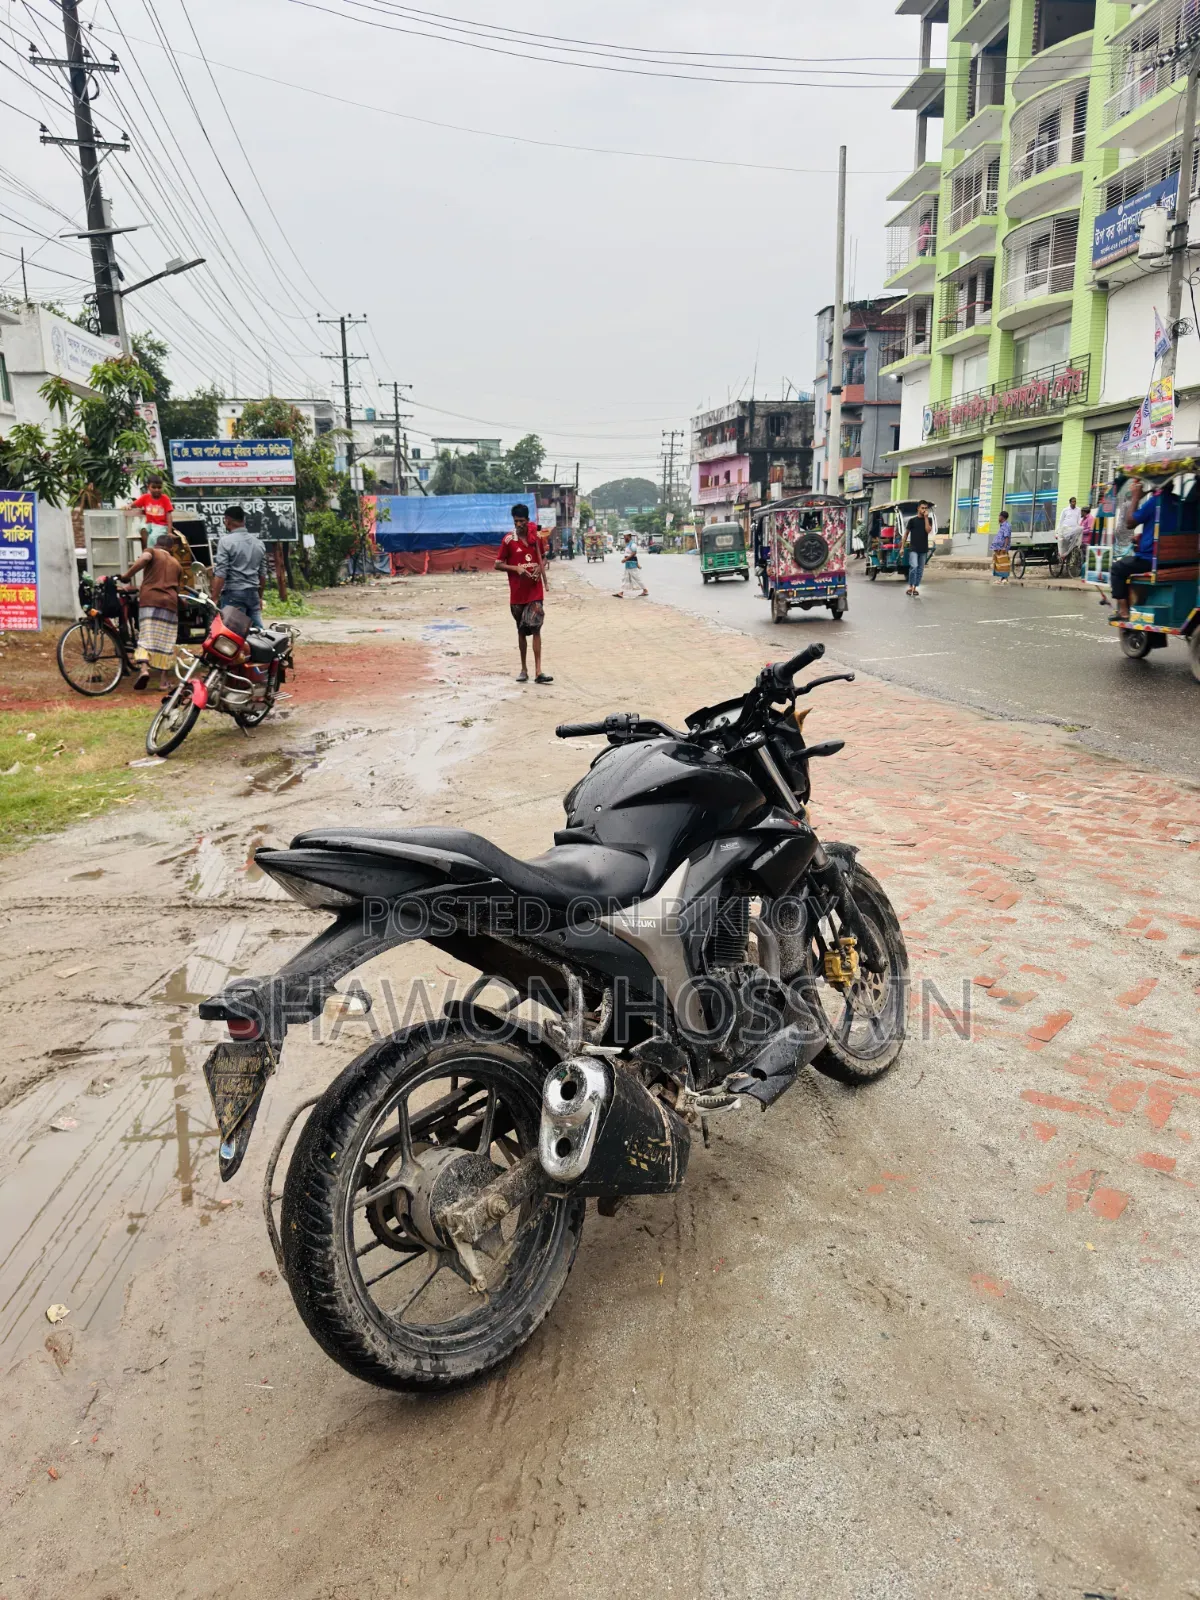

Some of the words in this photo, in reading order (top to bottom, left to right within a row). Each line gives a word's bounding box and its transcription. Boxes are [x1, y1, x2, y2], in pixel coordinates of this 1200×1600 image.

[204, 444, 221, 457] পার্সেল
[243, 498, 267, 515] হাই
[267, 500, 295, 516] স্কুল
[3, 525, 34, 542] সার্ভিস
[622, 919, 656, 928] SUZUKI
